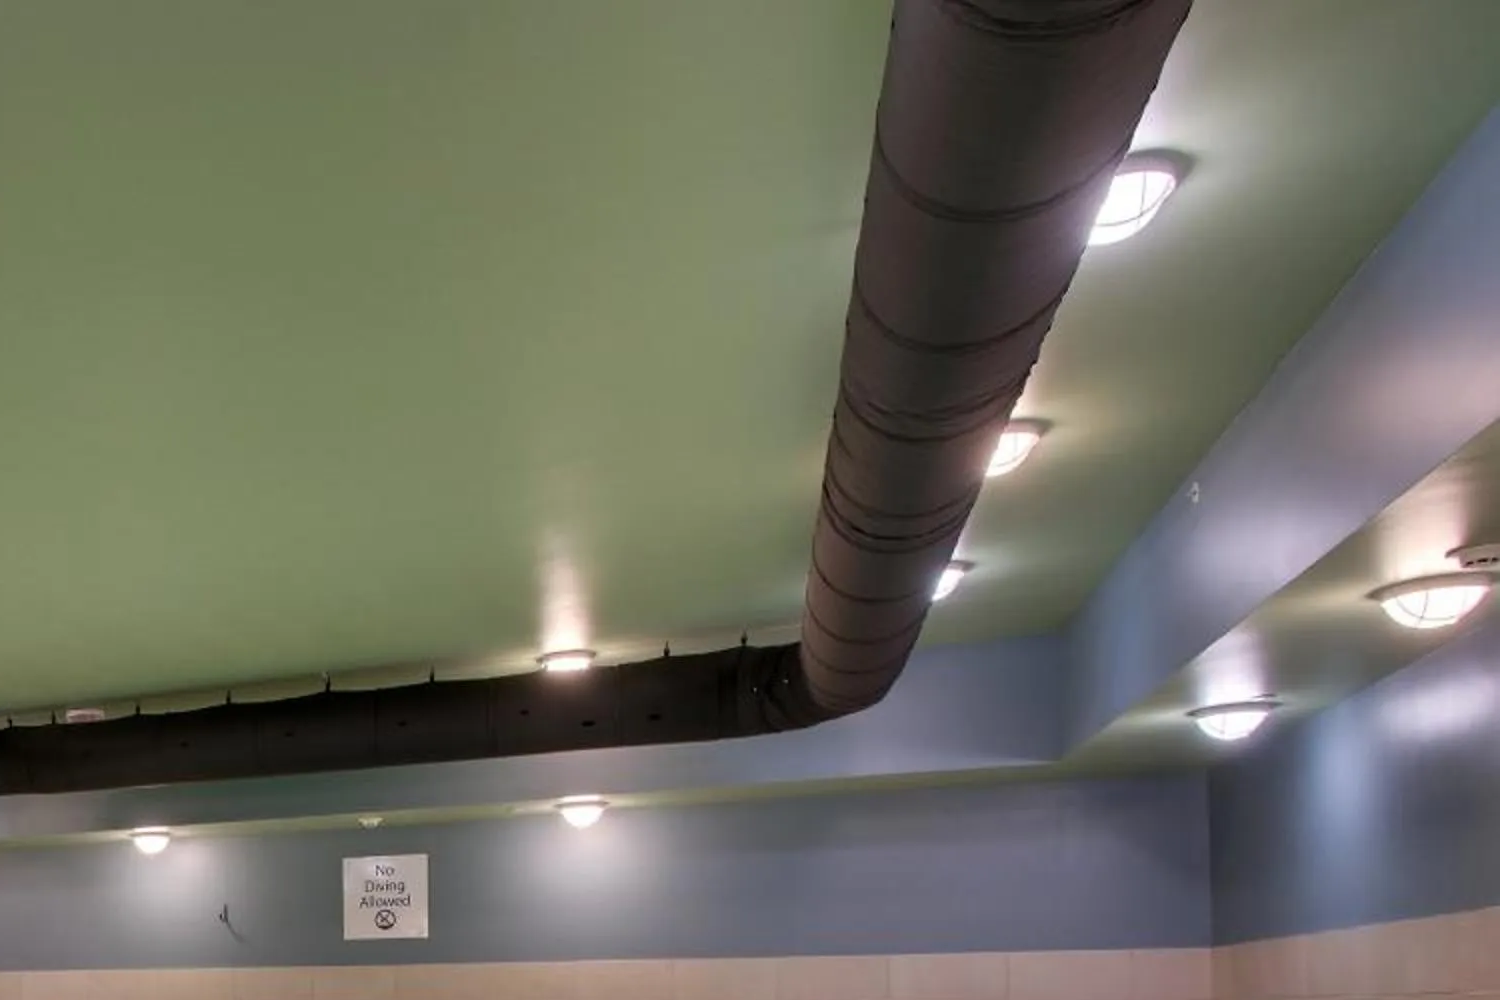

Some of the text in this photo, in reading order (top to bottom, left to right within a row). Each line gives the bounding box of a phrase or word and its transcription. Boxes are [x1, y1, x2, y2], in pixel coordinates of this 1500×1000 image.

[375, 864, 396, 877] No
[364, 880, 405, 894] Diving
[359, 893, 411, 909] Allowed
